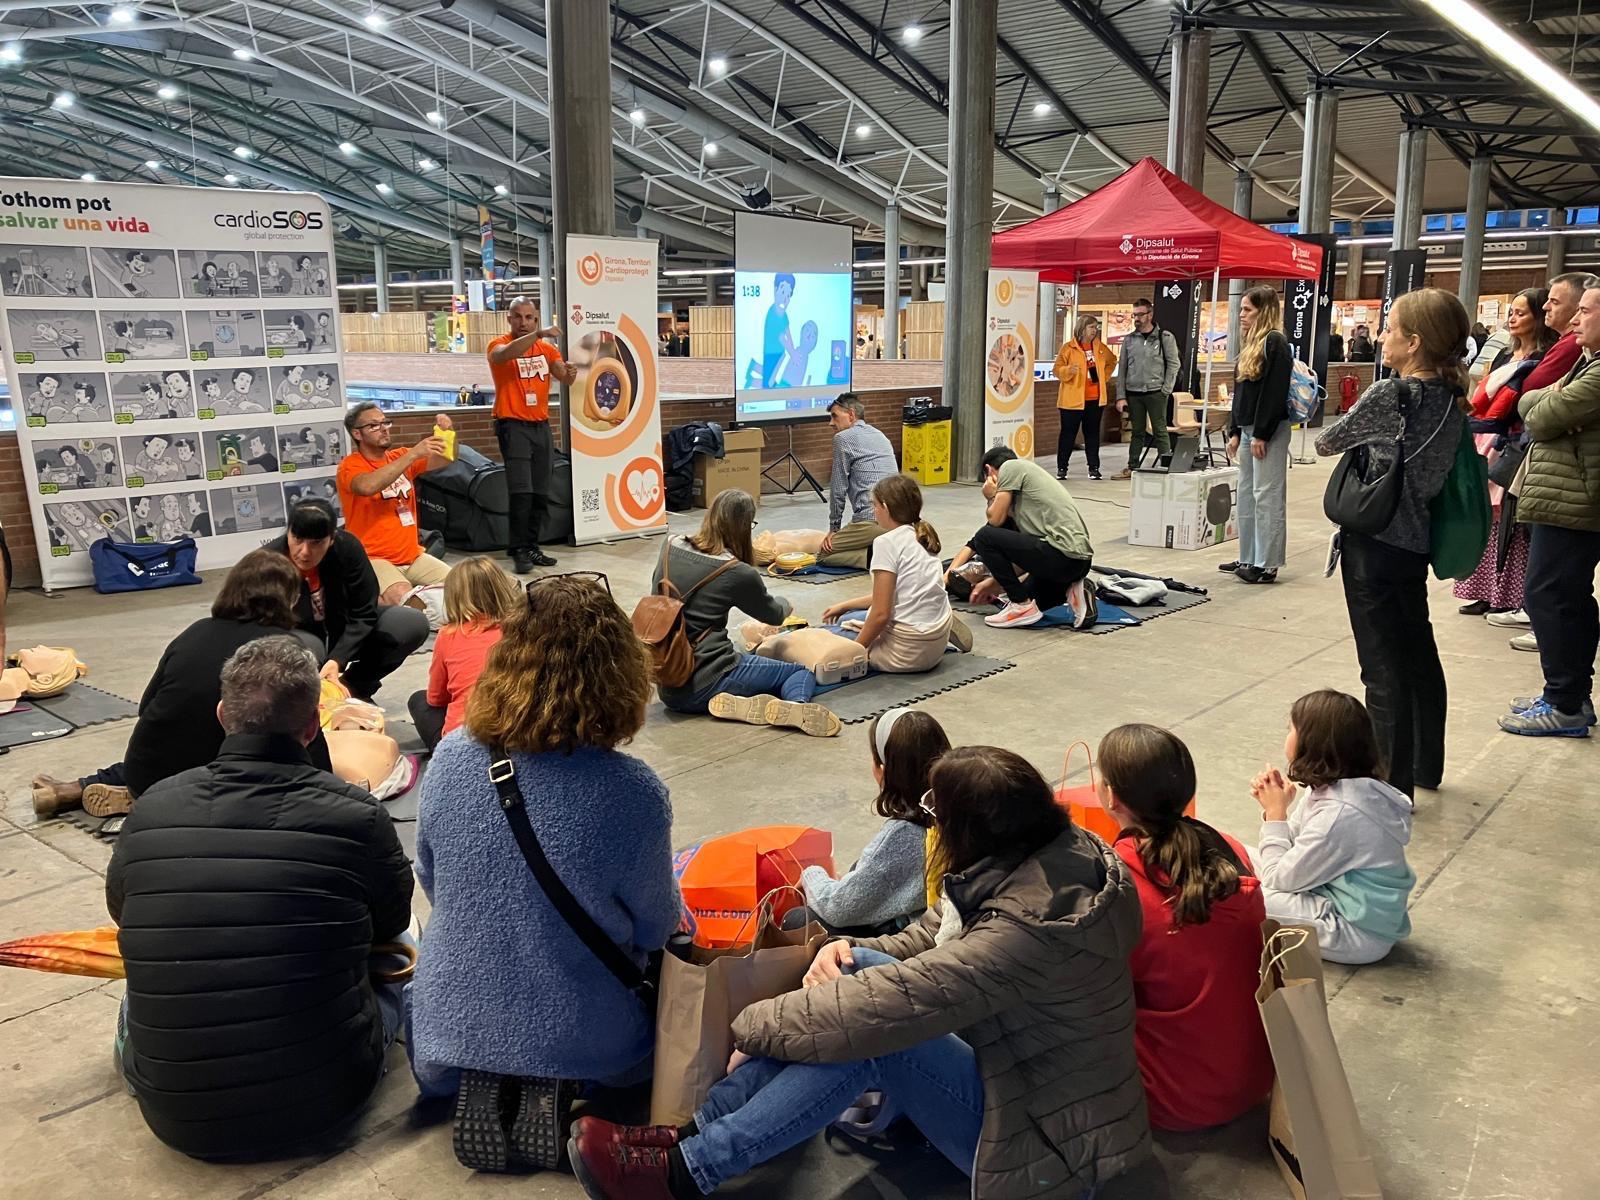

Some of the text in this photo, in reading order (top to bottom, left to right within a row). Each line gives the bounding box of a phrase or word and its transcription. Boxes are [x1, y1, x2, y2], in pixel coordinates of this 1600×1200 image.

[0, 191, 112, 214] othom pot
[63, 217, 102, 231] una
[106, 216, 150, 233] vida
[214, 210, 323, 230] cardioSOS
[244, 232, 304, 240] global protection
[1136, 238, 1174, 249] Dipsalut
[742, 285, 761, 297] 1:38
[585, 311, 609, 320] Dipsalut
[1294, 311, 1304, 339] Girona
